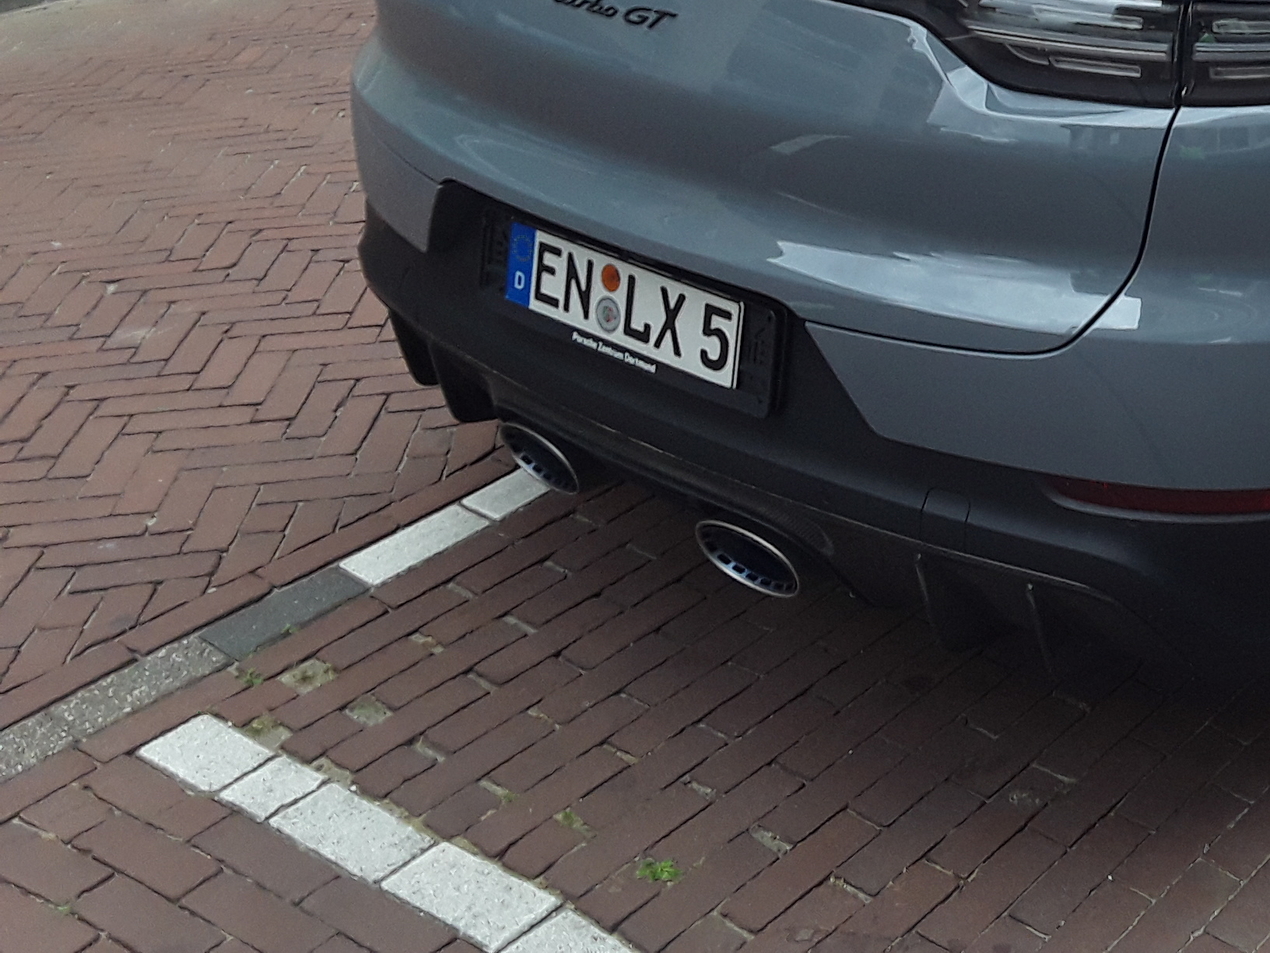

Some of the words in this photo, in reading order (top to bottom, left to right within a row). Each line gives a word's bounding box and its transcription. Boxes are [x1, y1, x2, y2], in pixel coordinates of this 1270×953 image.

[623, 6, 679, 29] GT
[514, 271, 525, 290] D
[533, 241, 594, 320] EN
[623, 274, 687, 358] LX
[699, 303, 733, 371] 5
